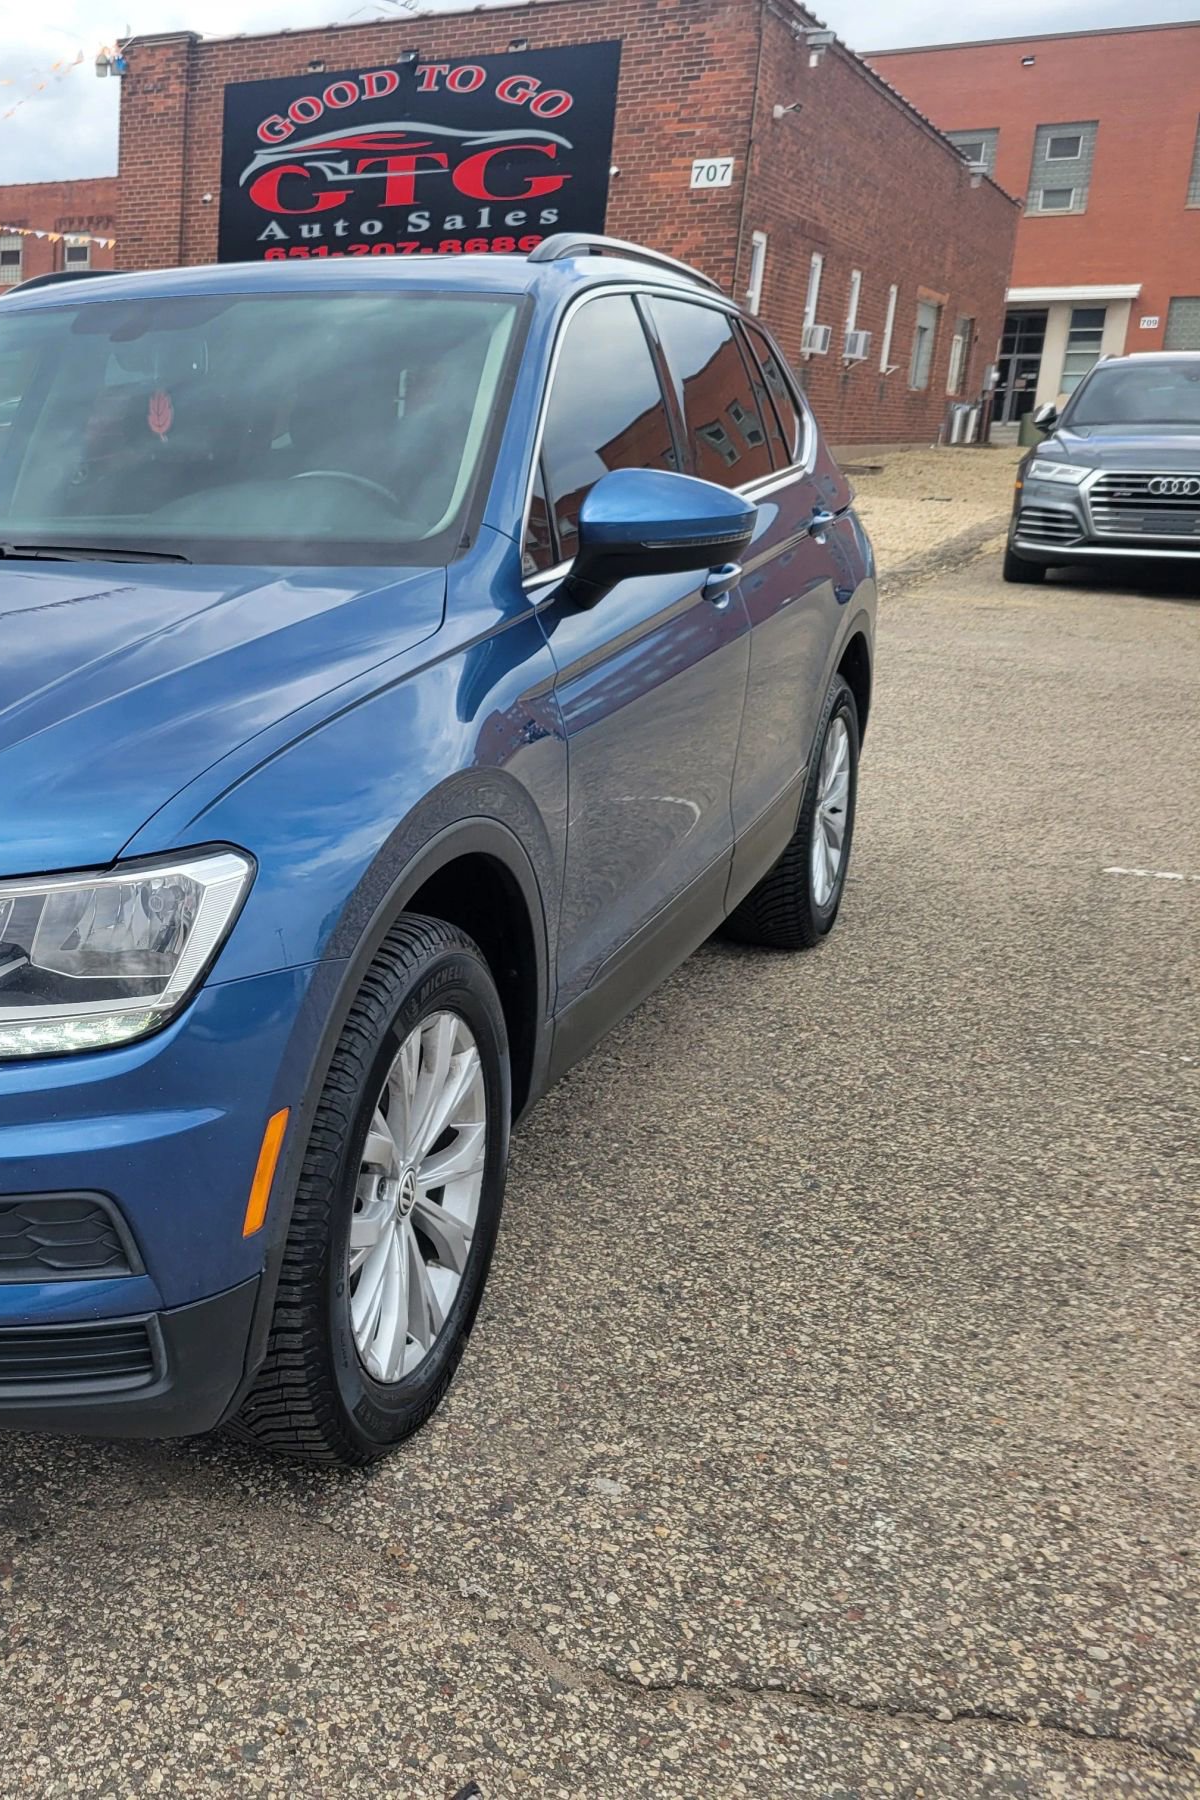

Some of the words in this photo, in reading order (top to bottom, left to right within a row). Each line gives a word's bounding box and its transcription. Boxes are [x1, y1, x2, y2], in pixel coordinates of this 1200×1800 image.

[256, 70, 400, 144] GOOD
[414, 64, 487, 93] TO
[494, 75, 574, 119] GO
[249, 143, 574, 214] GTG
[693, 163, 731, 183] 707
[256, 219, 384, 242] Auto
[406, 206, 560, 234] Sales
